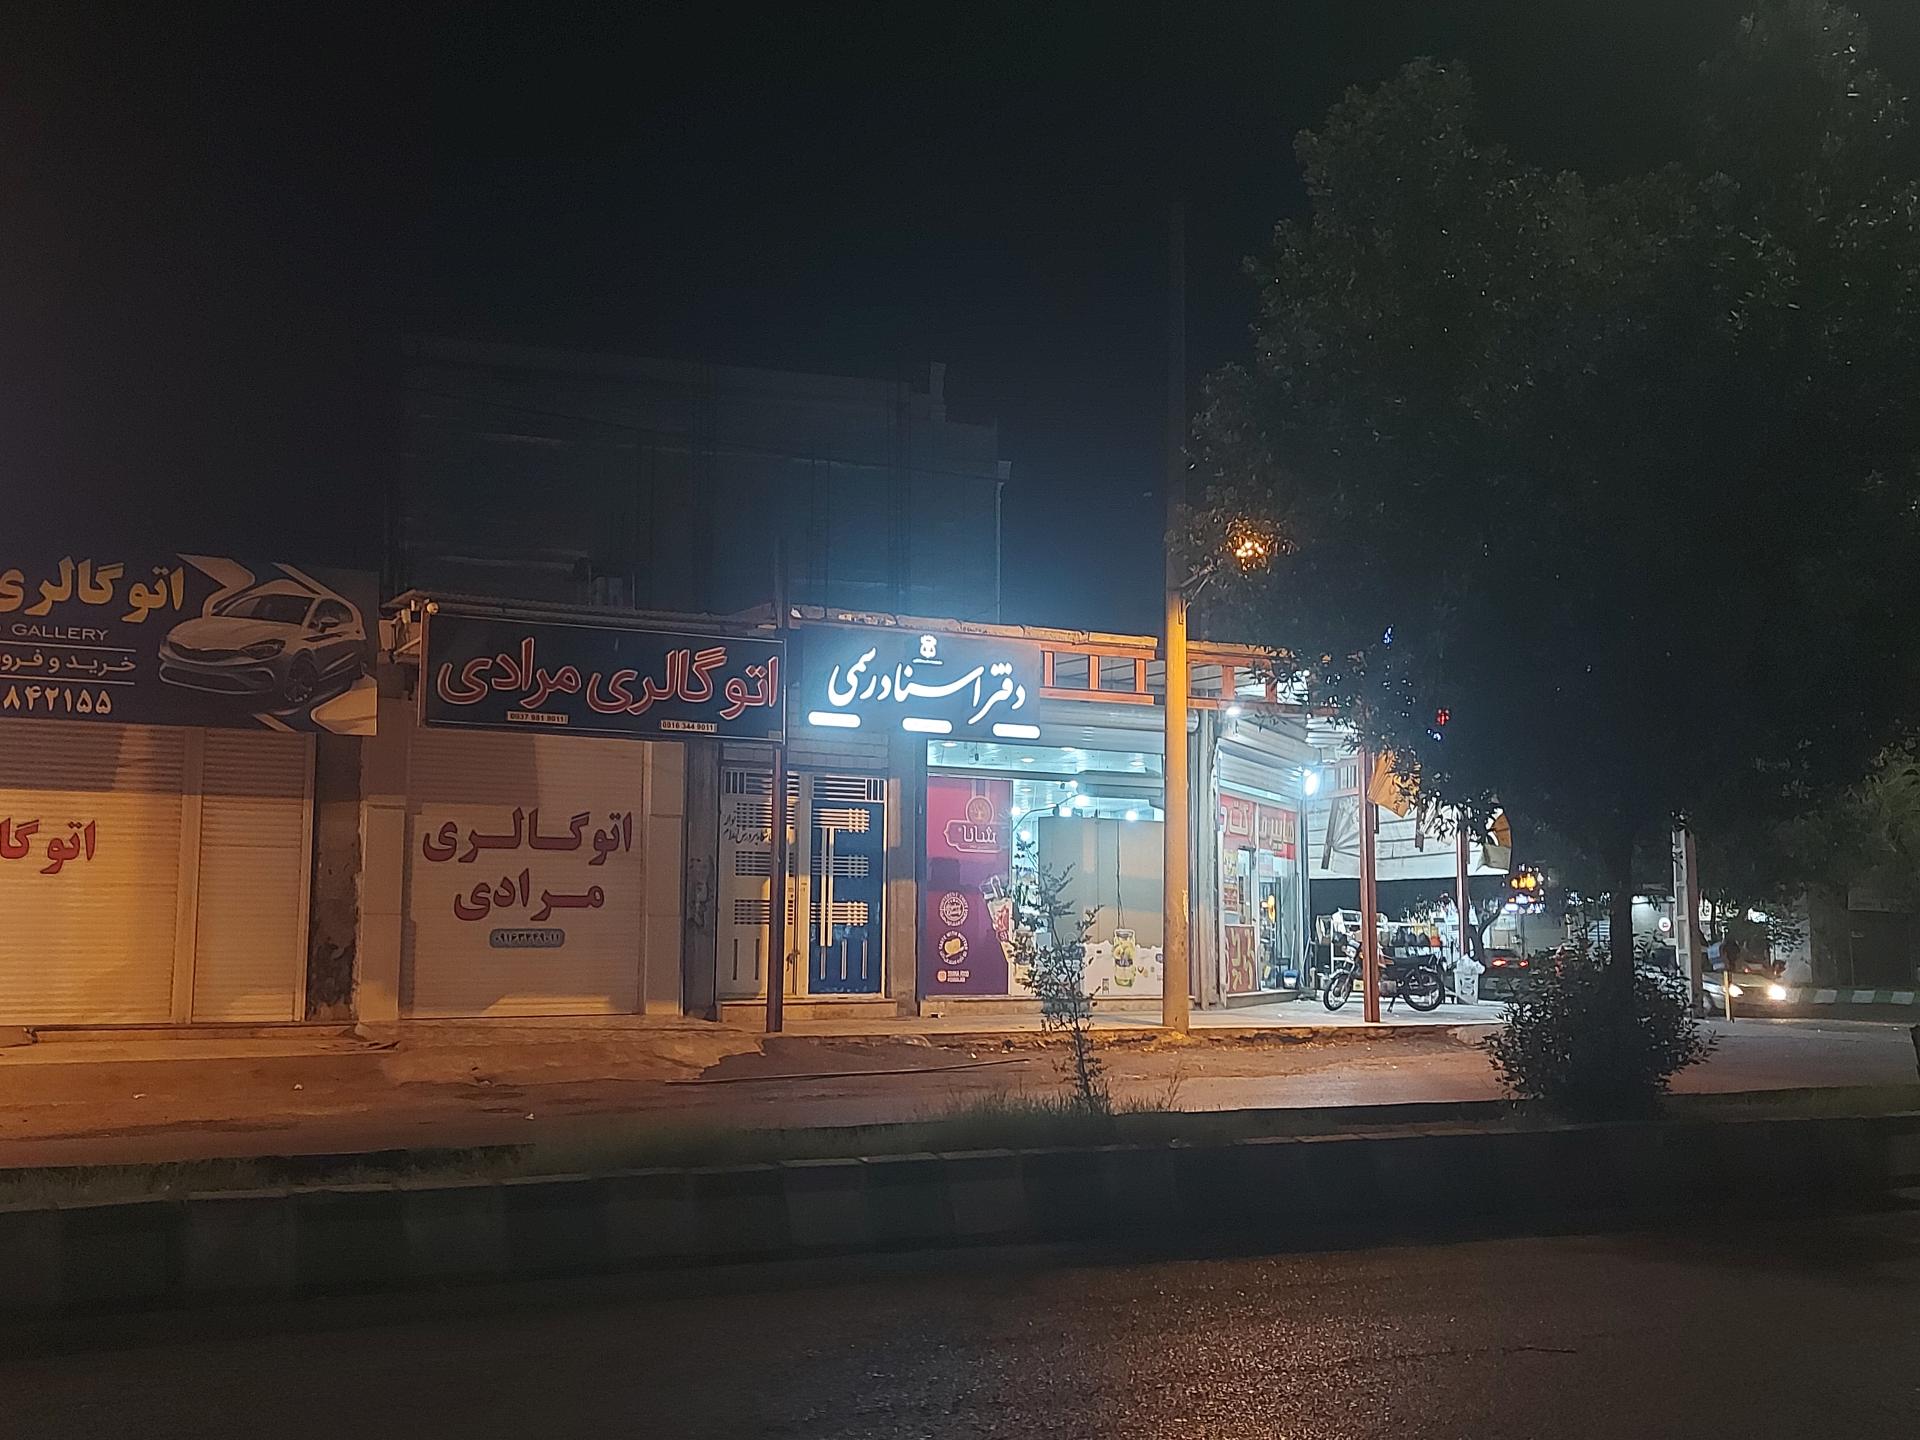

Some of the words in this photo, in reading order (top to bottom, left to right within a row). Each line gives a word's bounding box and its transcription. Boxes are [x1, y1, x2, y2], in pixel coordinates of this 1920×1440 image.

[0, 555, 125, 617] گالری
[121, 566, 184, 623] اتو
[11, 623, 108, 642] GALLERY
[0, 649, 44, 672] فرو
[48, 657, 61, 673] و
[66, 656, 137, 677] خرید
[437, 636, 582, 710] مرادی
[586, 646, 727, 715] گالری
[828, 647, 877, 707] رسمی
[877, 661, 985, 707] اسناد
[2, 685, 112, 714] ۸۴۲۱۵۵
[719, 655, 779, 721] اتو
[968, 661, 1026, 725] دفتر
[40, 819, 96, 874] اتو
[423, 806, 590, 863] گالری
[588, 811, 632, 865] اتو
[962, 824, 997, 844] شانا
[454, 868, 605, 922] مرادی
